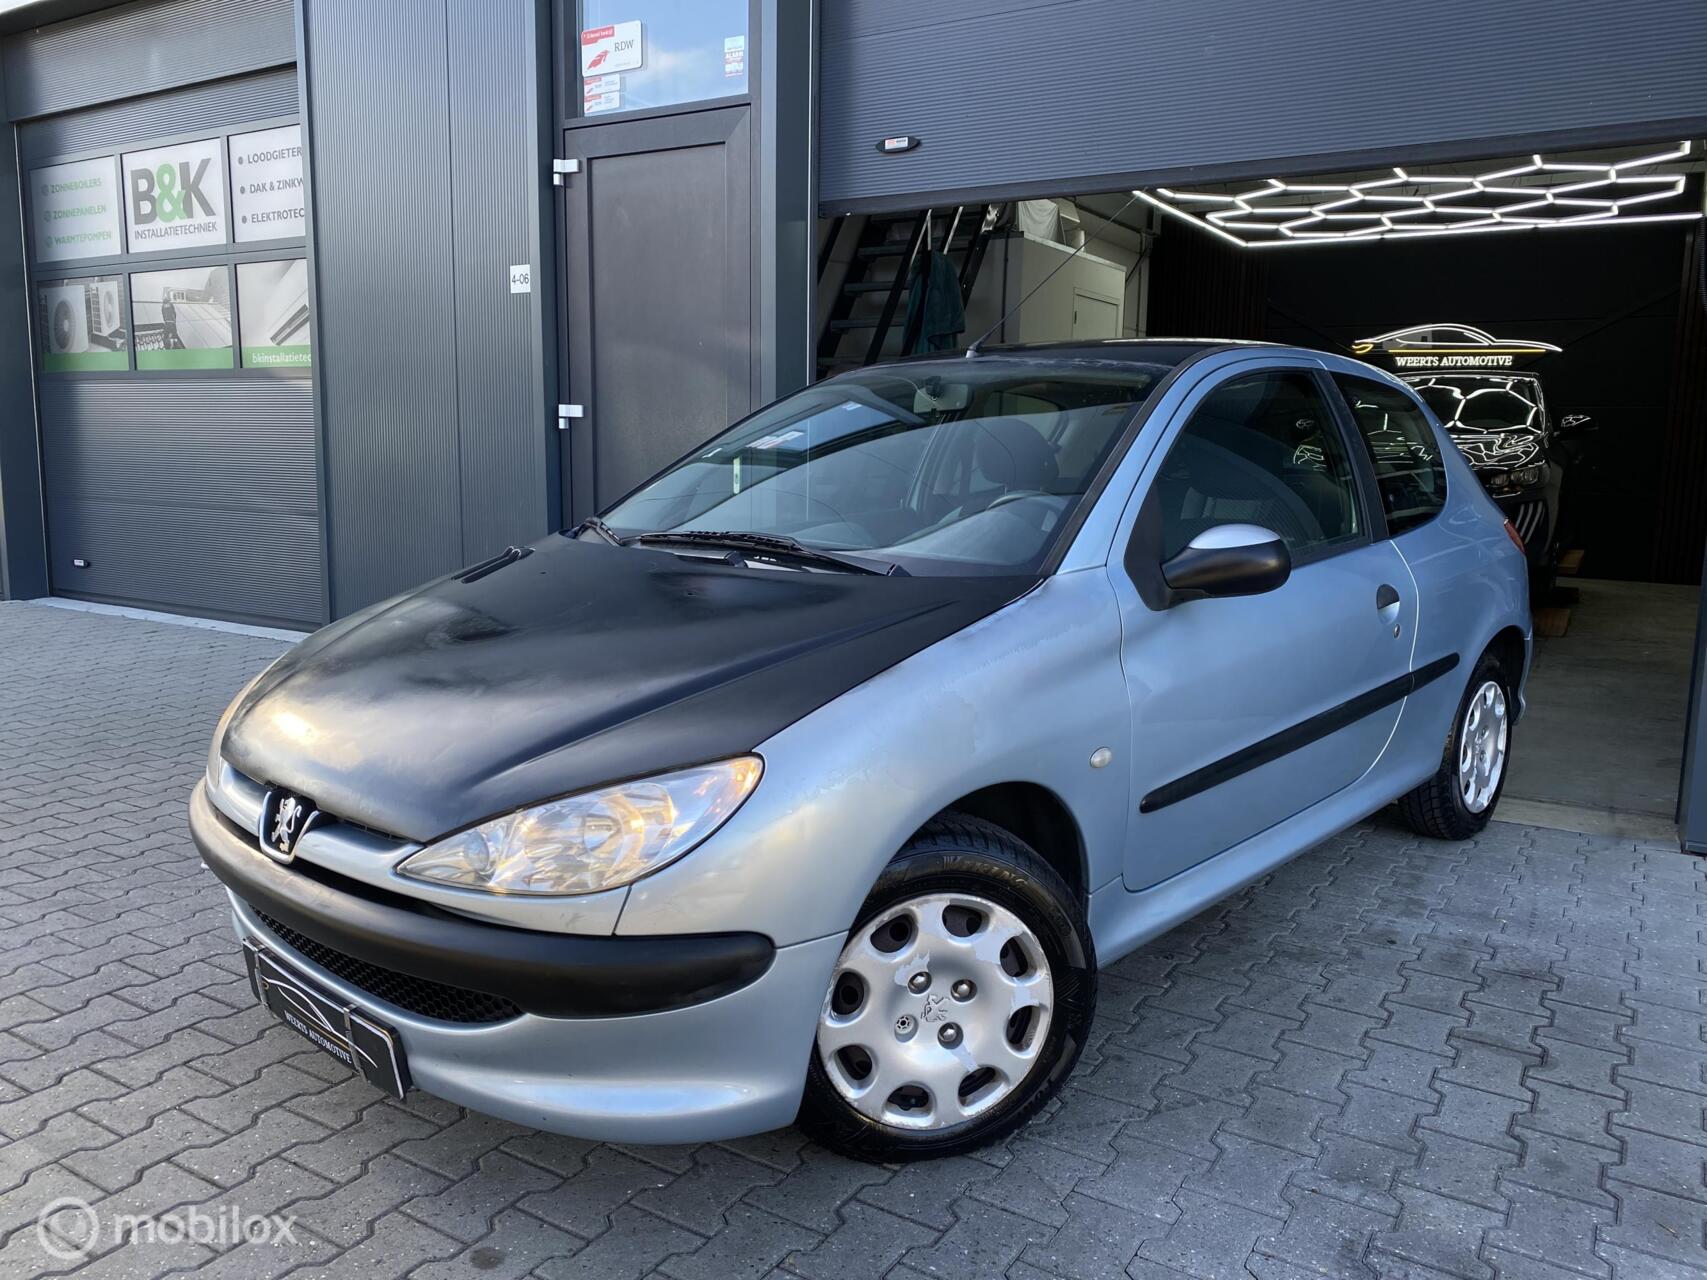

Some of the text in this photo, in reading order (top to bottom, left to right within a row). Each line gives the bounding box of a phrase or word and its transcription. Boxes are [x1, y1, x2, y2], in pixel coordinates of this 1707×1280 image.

[614, 40, 634, 52] RDW
[247, 147, 302, 164] LOODGIETER
[130, 158, 216, 225] B&K
[249, 183, 267, 194] DAK
[269, 181, 274, 191] &
[53, 204, 106, 220] ZONNEPANELEN
[251, 208, 305, 223] ELEKTROTEC
[134, 221, 217, 240] INSTALLATIETECHNIEK
[511, 273, 530, 285] 4-06
[252, 352, 311, 363] bkinstallatietec
[1395, 355, 1512, 367] WEERTS AUTOMOTIVE
[284, 1010, 352, 1064] WEERTS AUTOMOTIVE
